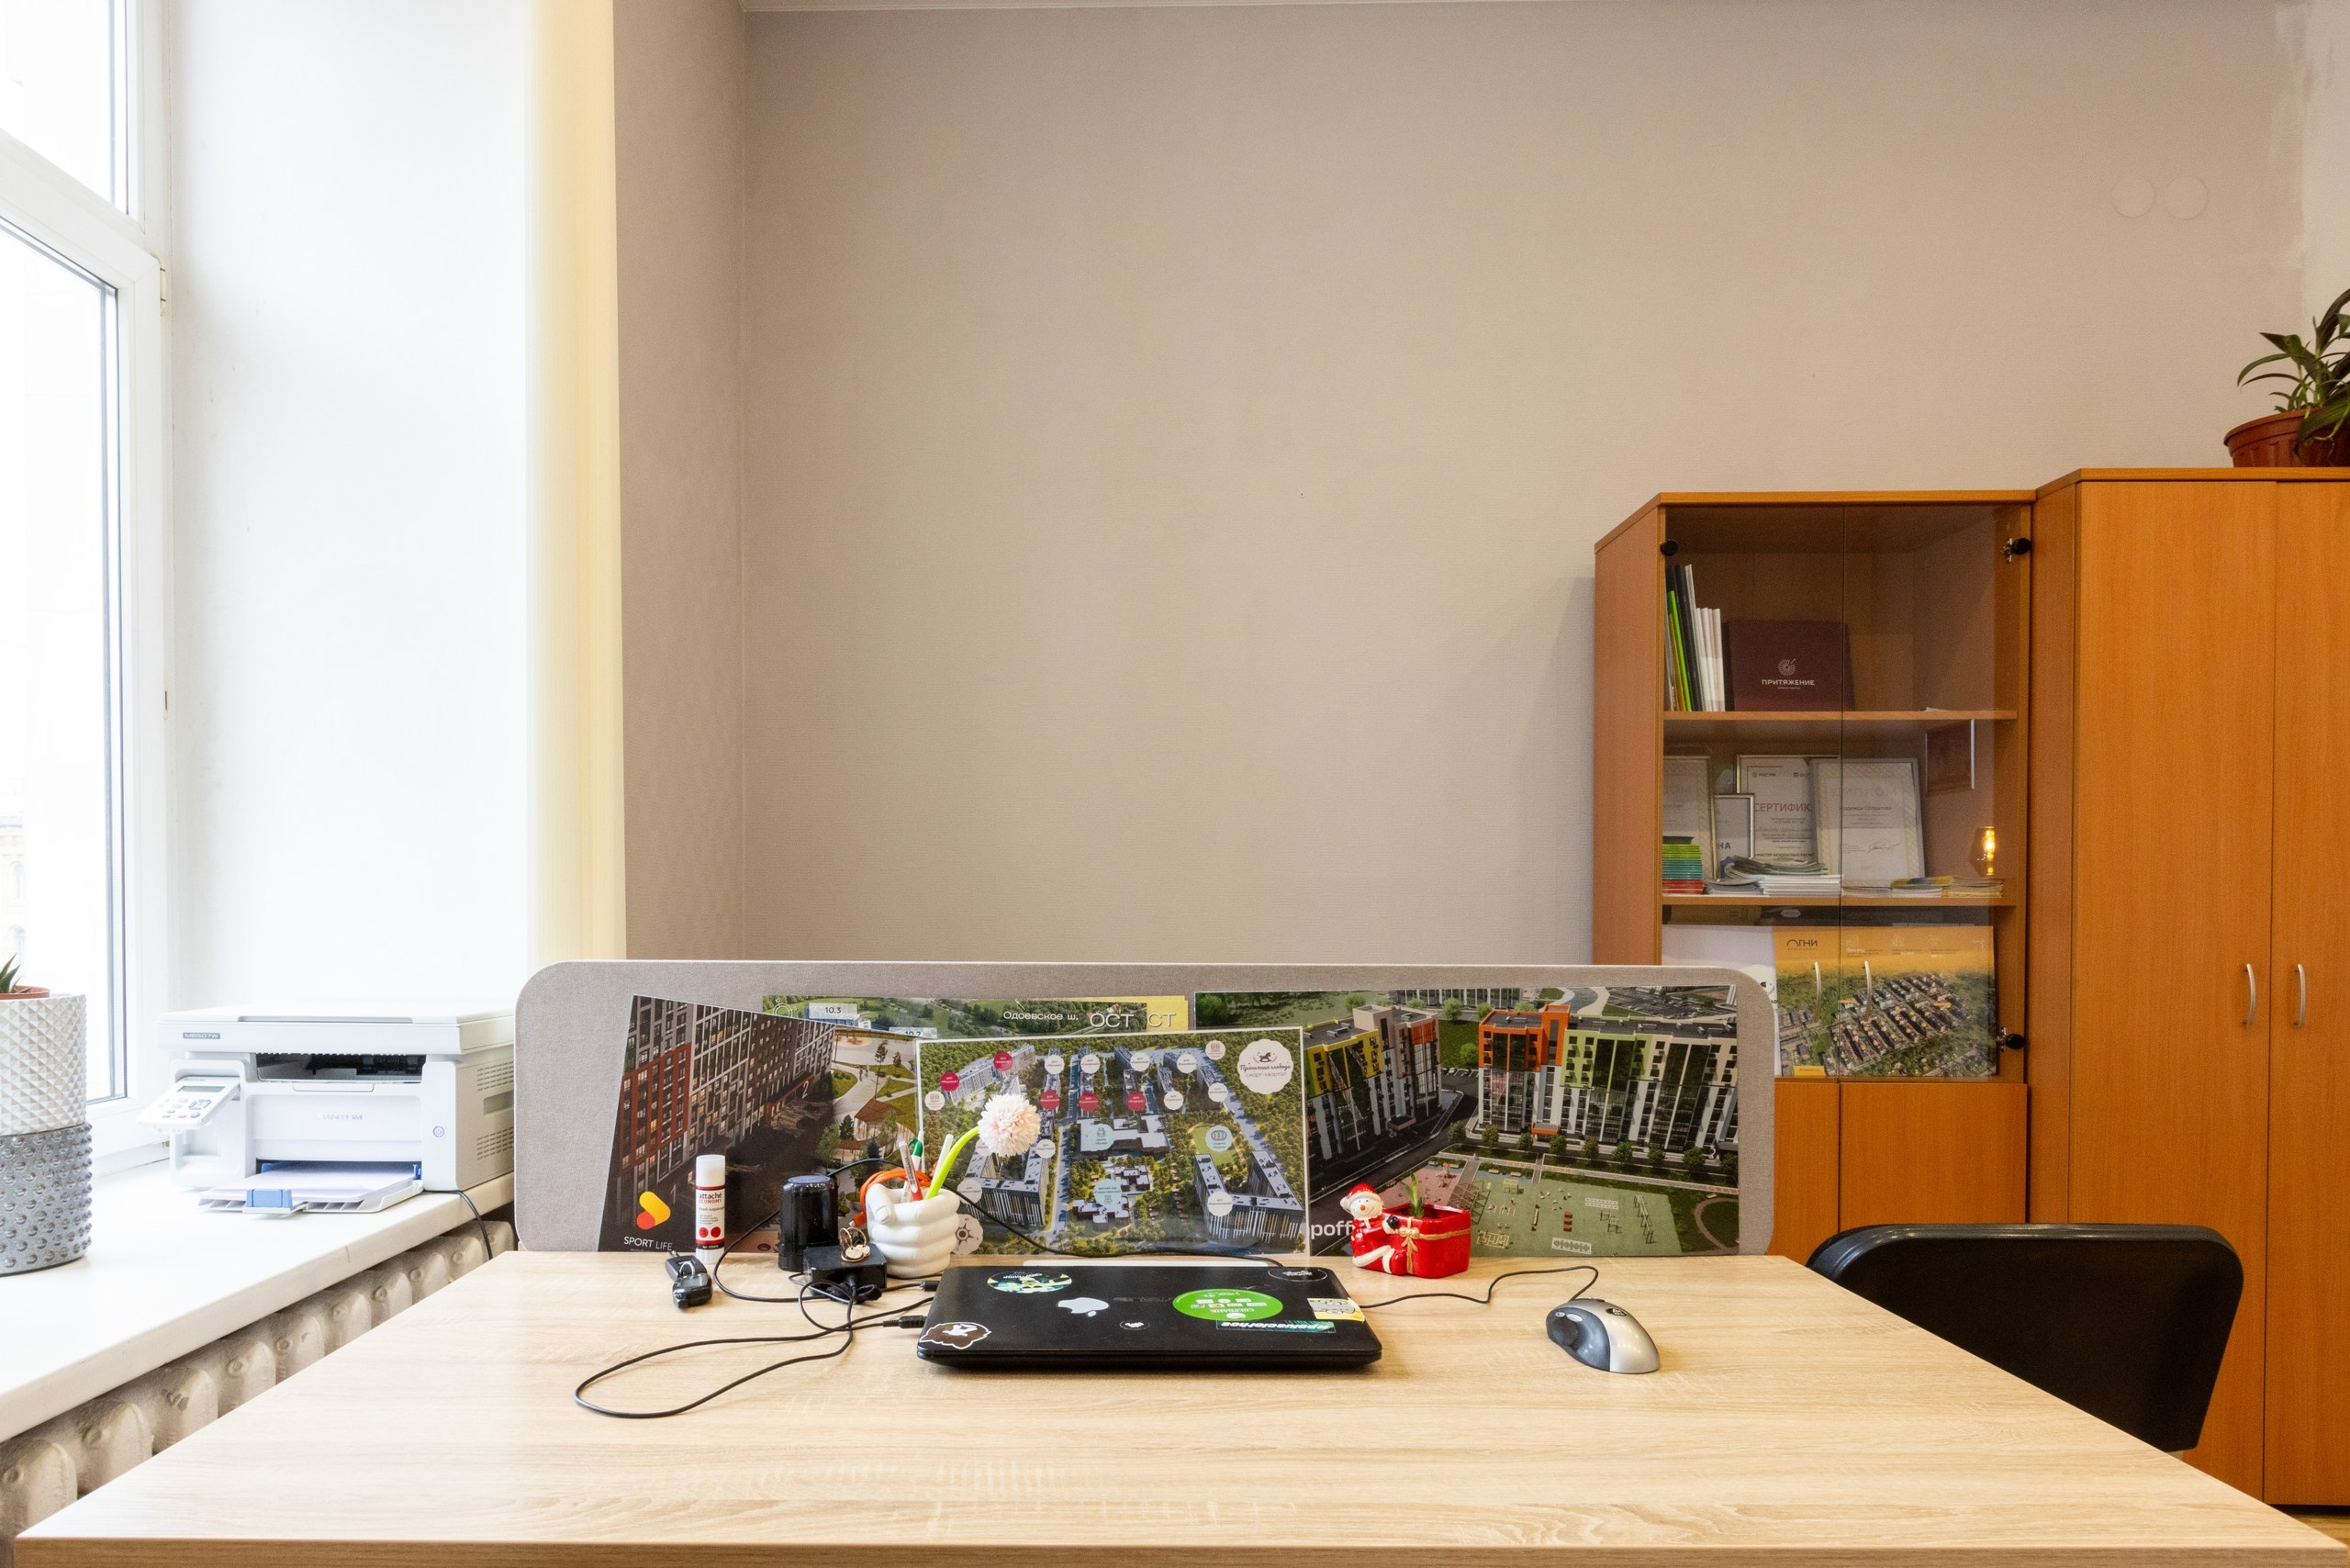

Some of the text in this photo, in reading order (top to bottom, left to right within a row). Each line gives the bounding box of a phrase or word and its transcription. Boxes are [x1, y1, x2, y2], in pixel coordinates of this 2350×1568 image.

[1755, 803, 1814, 812] СЕРТИФИК
[825, 1006, 842, 1014] 10.3
[1003, 1011, 1064, 1021] Одоевское
[801, 1080, 809, 1099] 2
[623, 1236, 674, 1251] SPORT LIFE
